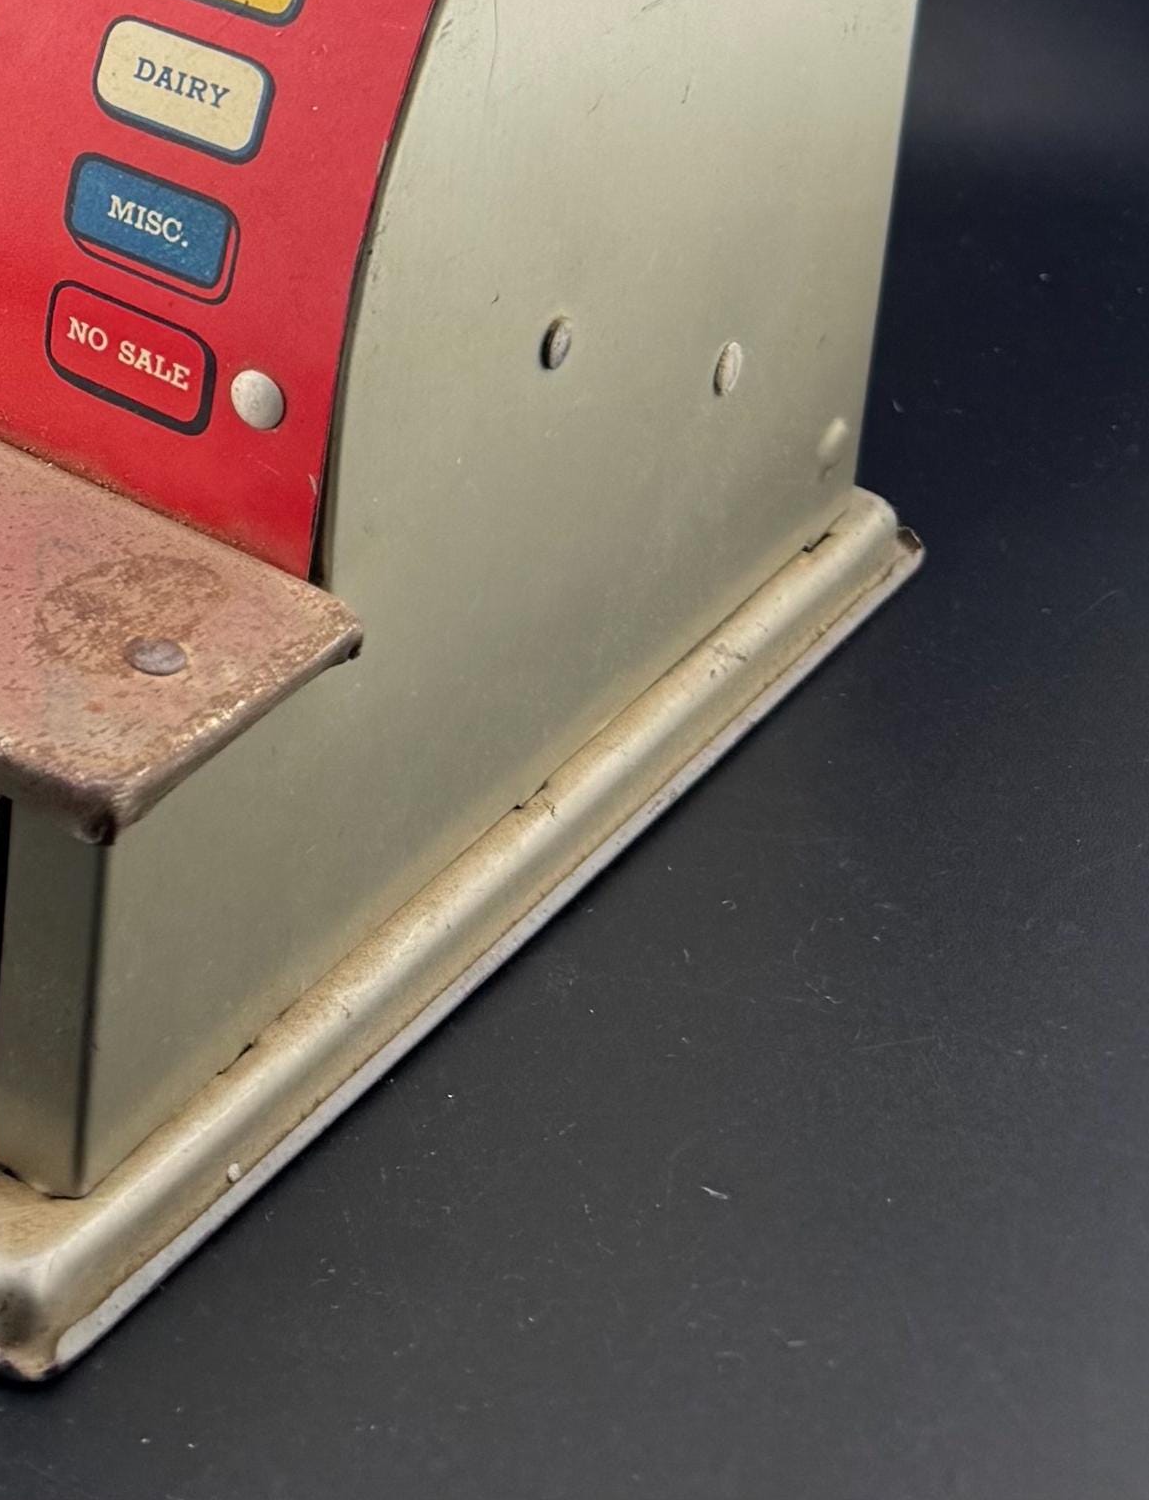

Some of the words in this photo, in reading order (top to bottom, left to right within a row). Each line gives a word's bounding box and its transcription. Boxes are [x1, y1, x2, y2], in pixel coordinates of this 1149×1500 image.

[133, 56, 231, 109] DAIRY
[107, 194, 189, 248] MISC.
[66, 316, 109, 352] NO
[117, 340, 191, 391] SALE
